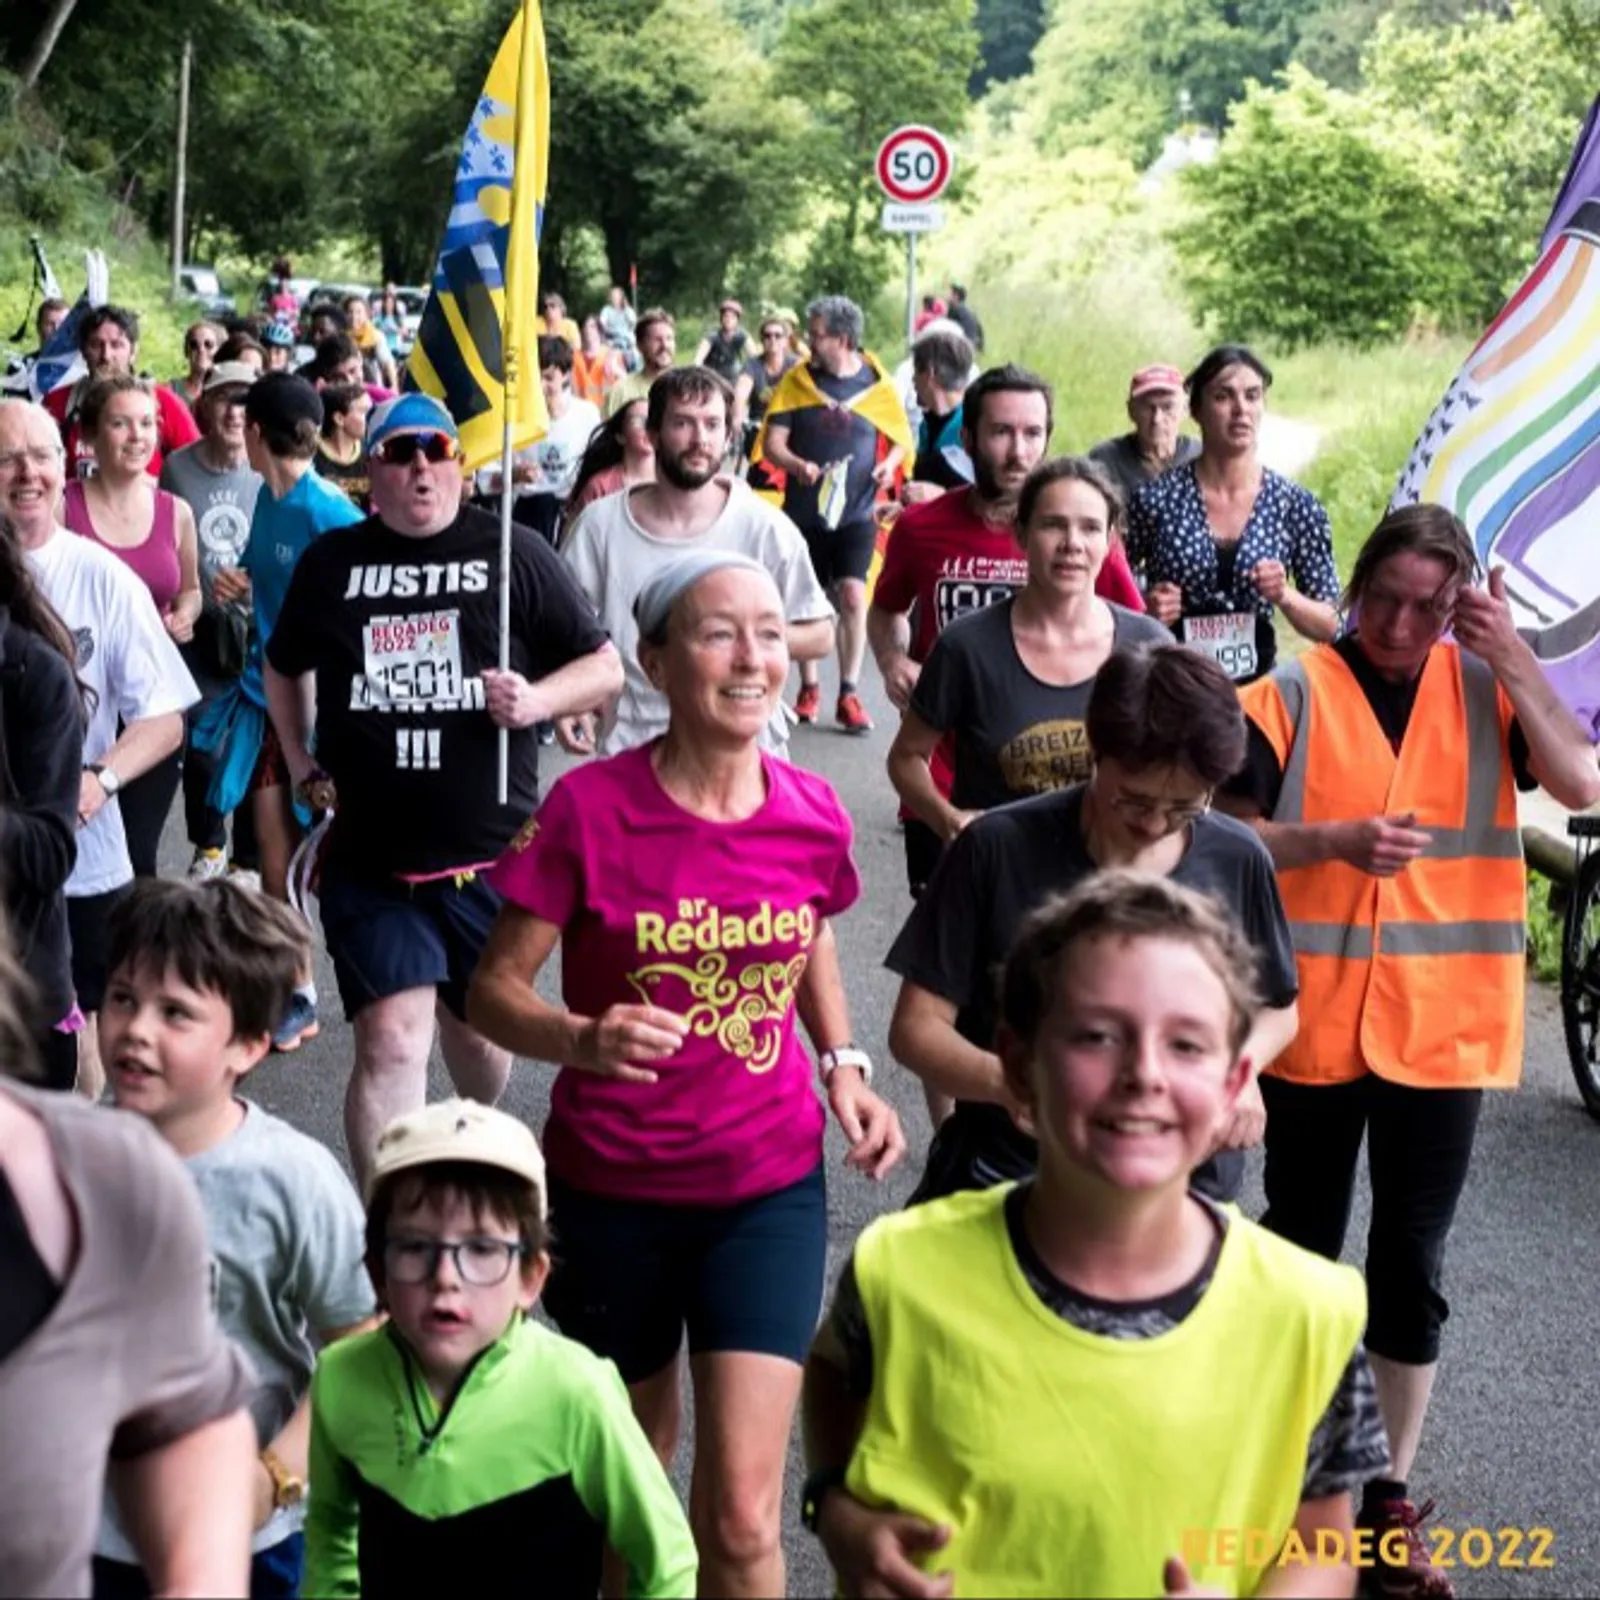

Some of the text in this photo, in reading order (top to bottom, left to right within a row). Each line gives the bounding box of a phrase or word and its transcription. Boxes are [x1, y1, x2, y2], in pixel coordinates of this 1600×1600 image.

[893, 151, 935, 182] 50
[344, 559, 489, 600] JUSTIS
[371, 616, 450, 640] REDADEG
[372, 637, 416, 654] 2022
[375, 658, 455, 699] 1501
[396, 728, 441, 770] !!!
[678, 897, 708, 918] ar
[635, 901, 814, 954] Redadeg
